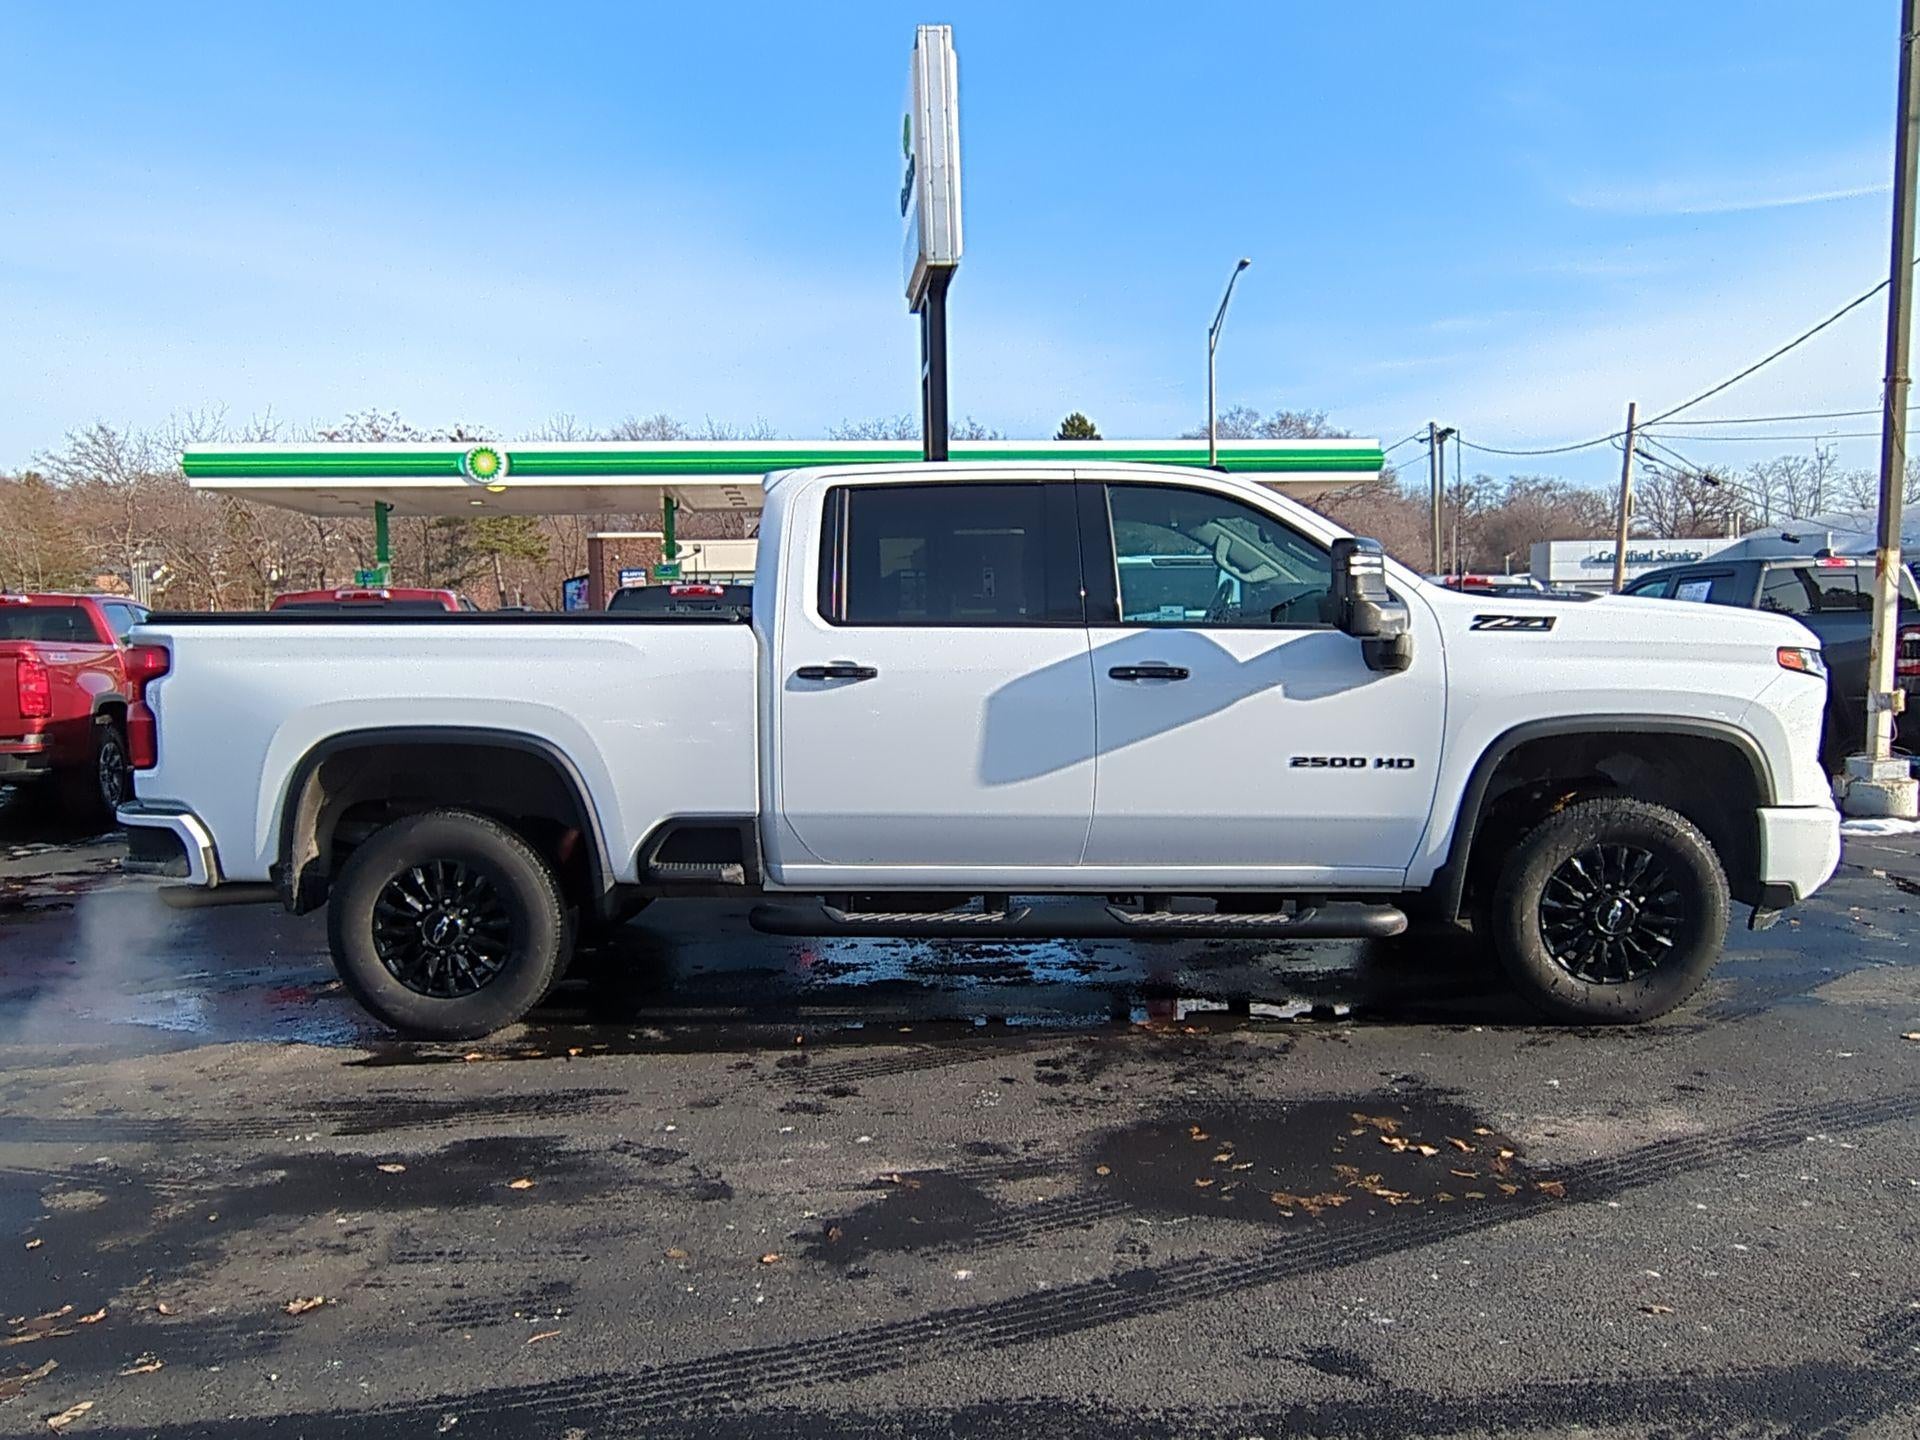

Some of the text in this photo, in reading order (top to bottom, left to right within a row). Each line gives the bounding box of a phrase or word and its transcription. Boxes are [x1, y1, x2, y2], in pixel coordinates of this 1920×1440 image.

[1599, 549, 1703, 562] Ceified Service
[1469, 614, 1557, 632] Z71
[1289, 756, 1415, 769] 2500 HD
